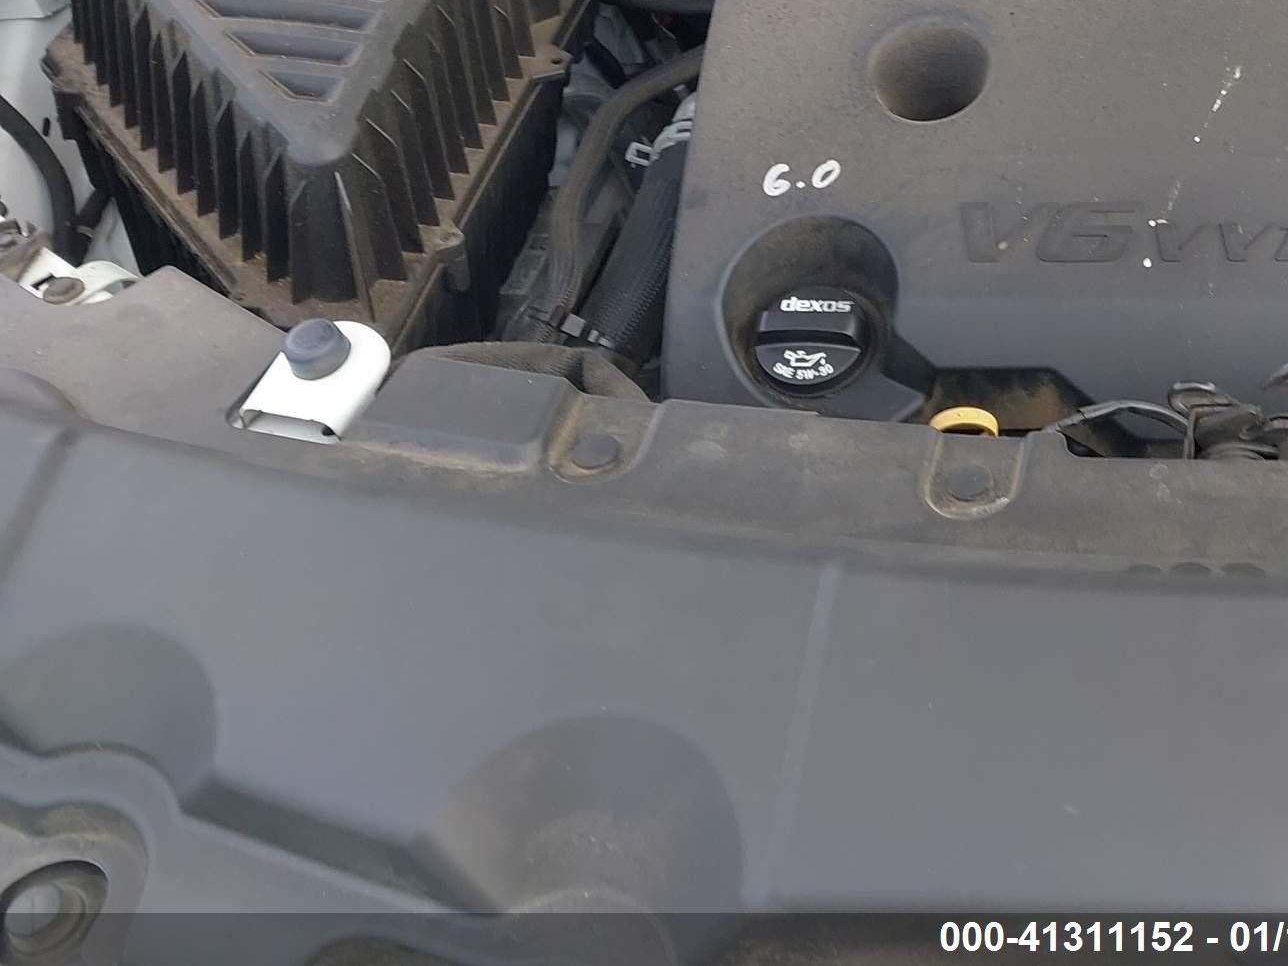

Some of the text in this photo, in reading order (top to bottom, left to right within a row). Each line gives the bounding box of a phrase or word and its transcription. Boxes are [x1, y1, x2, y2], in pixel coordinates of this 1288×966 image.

[763, 160, 841, 197] 6.0
[959, 201, 1144, 263] V6
[780, 296, 855, 313] dexos
[796, 363, 835, 380] 5W-30
